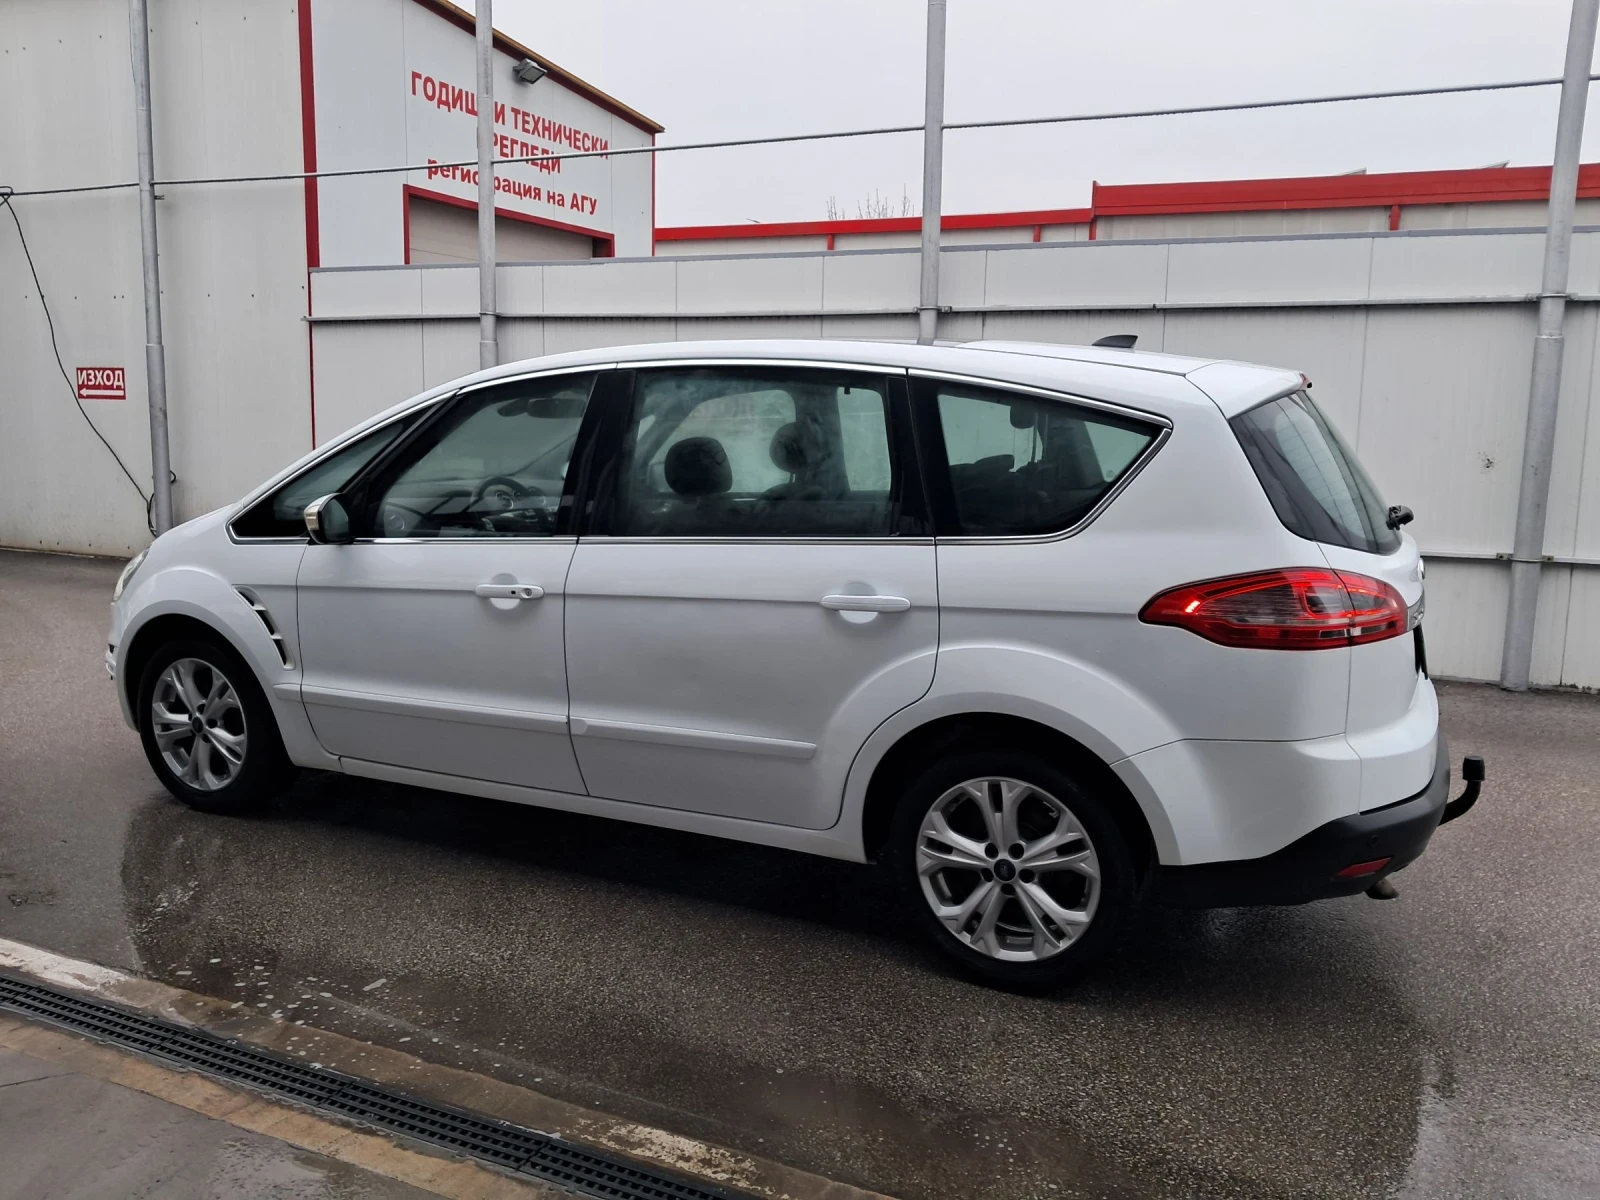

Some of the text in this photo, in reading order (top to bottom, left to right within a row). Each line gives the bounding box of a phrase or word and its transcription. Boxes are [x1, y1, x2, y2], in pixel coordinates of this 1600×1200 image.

[411, 70, 608, 159] ГОДИШИ ТЕХНИЧЕСКИ
[428, 158, 597, 215] регисрация на АГУ
[77, 369, 124, 389] ИЗХОД
